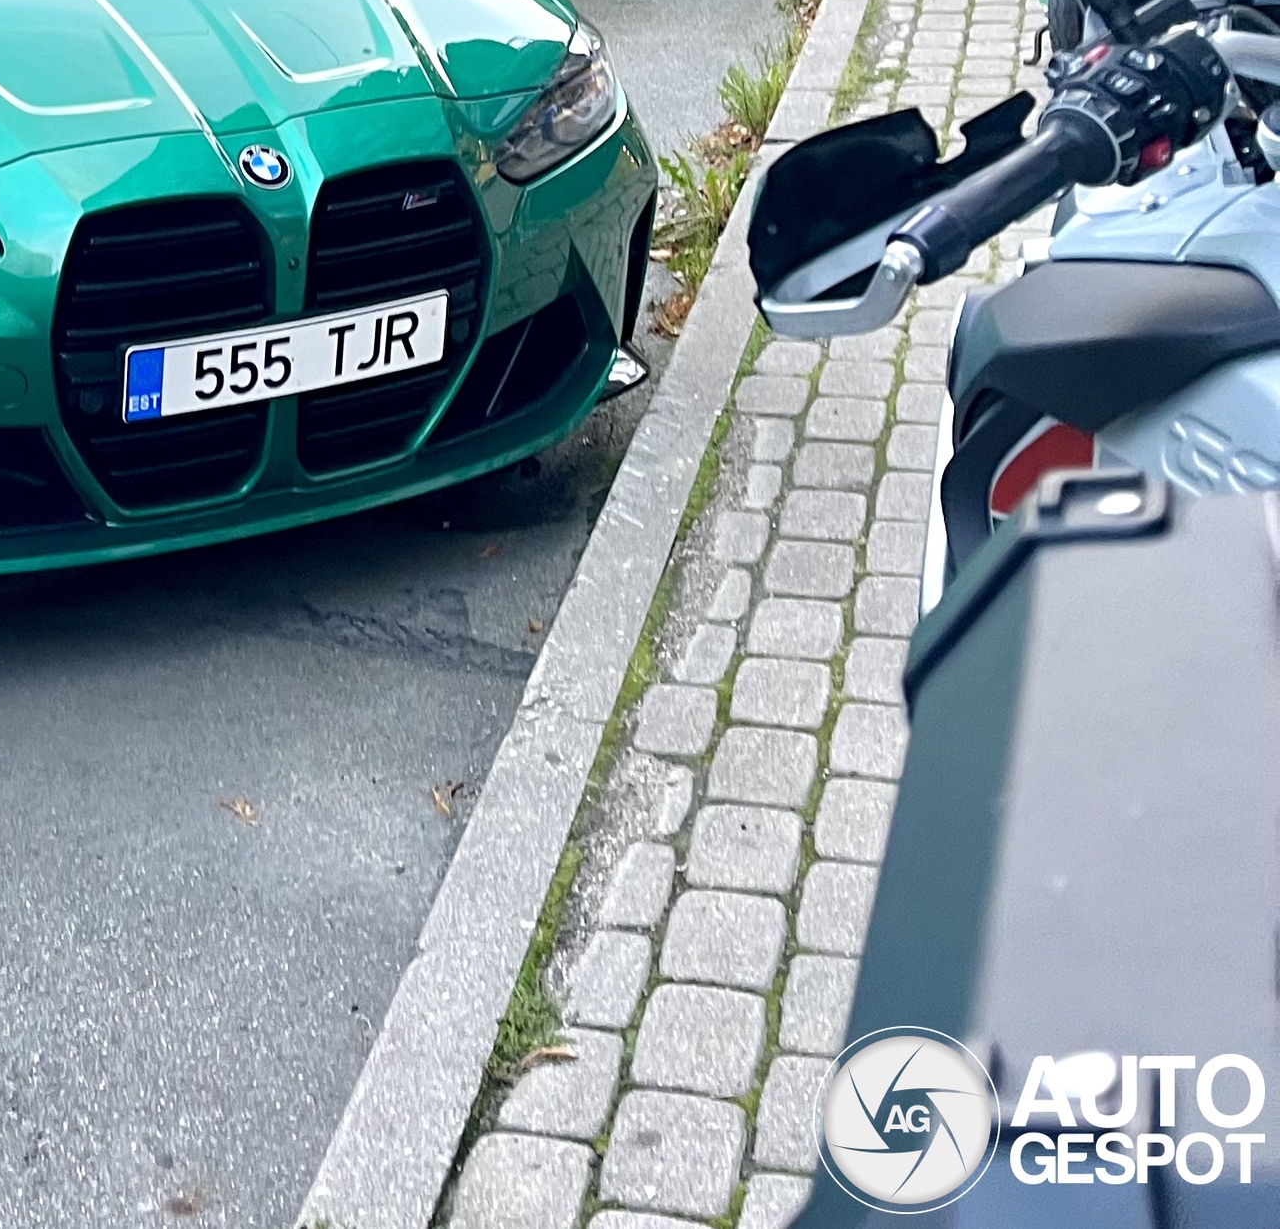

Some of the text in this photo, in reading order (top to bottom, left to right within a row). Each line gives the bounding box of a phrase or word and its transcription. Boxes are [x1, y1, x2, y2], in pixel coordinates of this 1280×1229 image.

[194, 311, 420, 401] 555 TJR
[128, 392, 161, 413] EST
